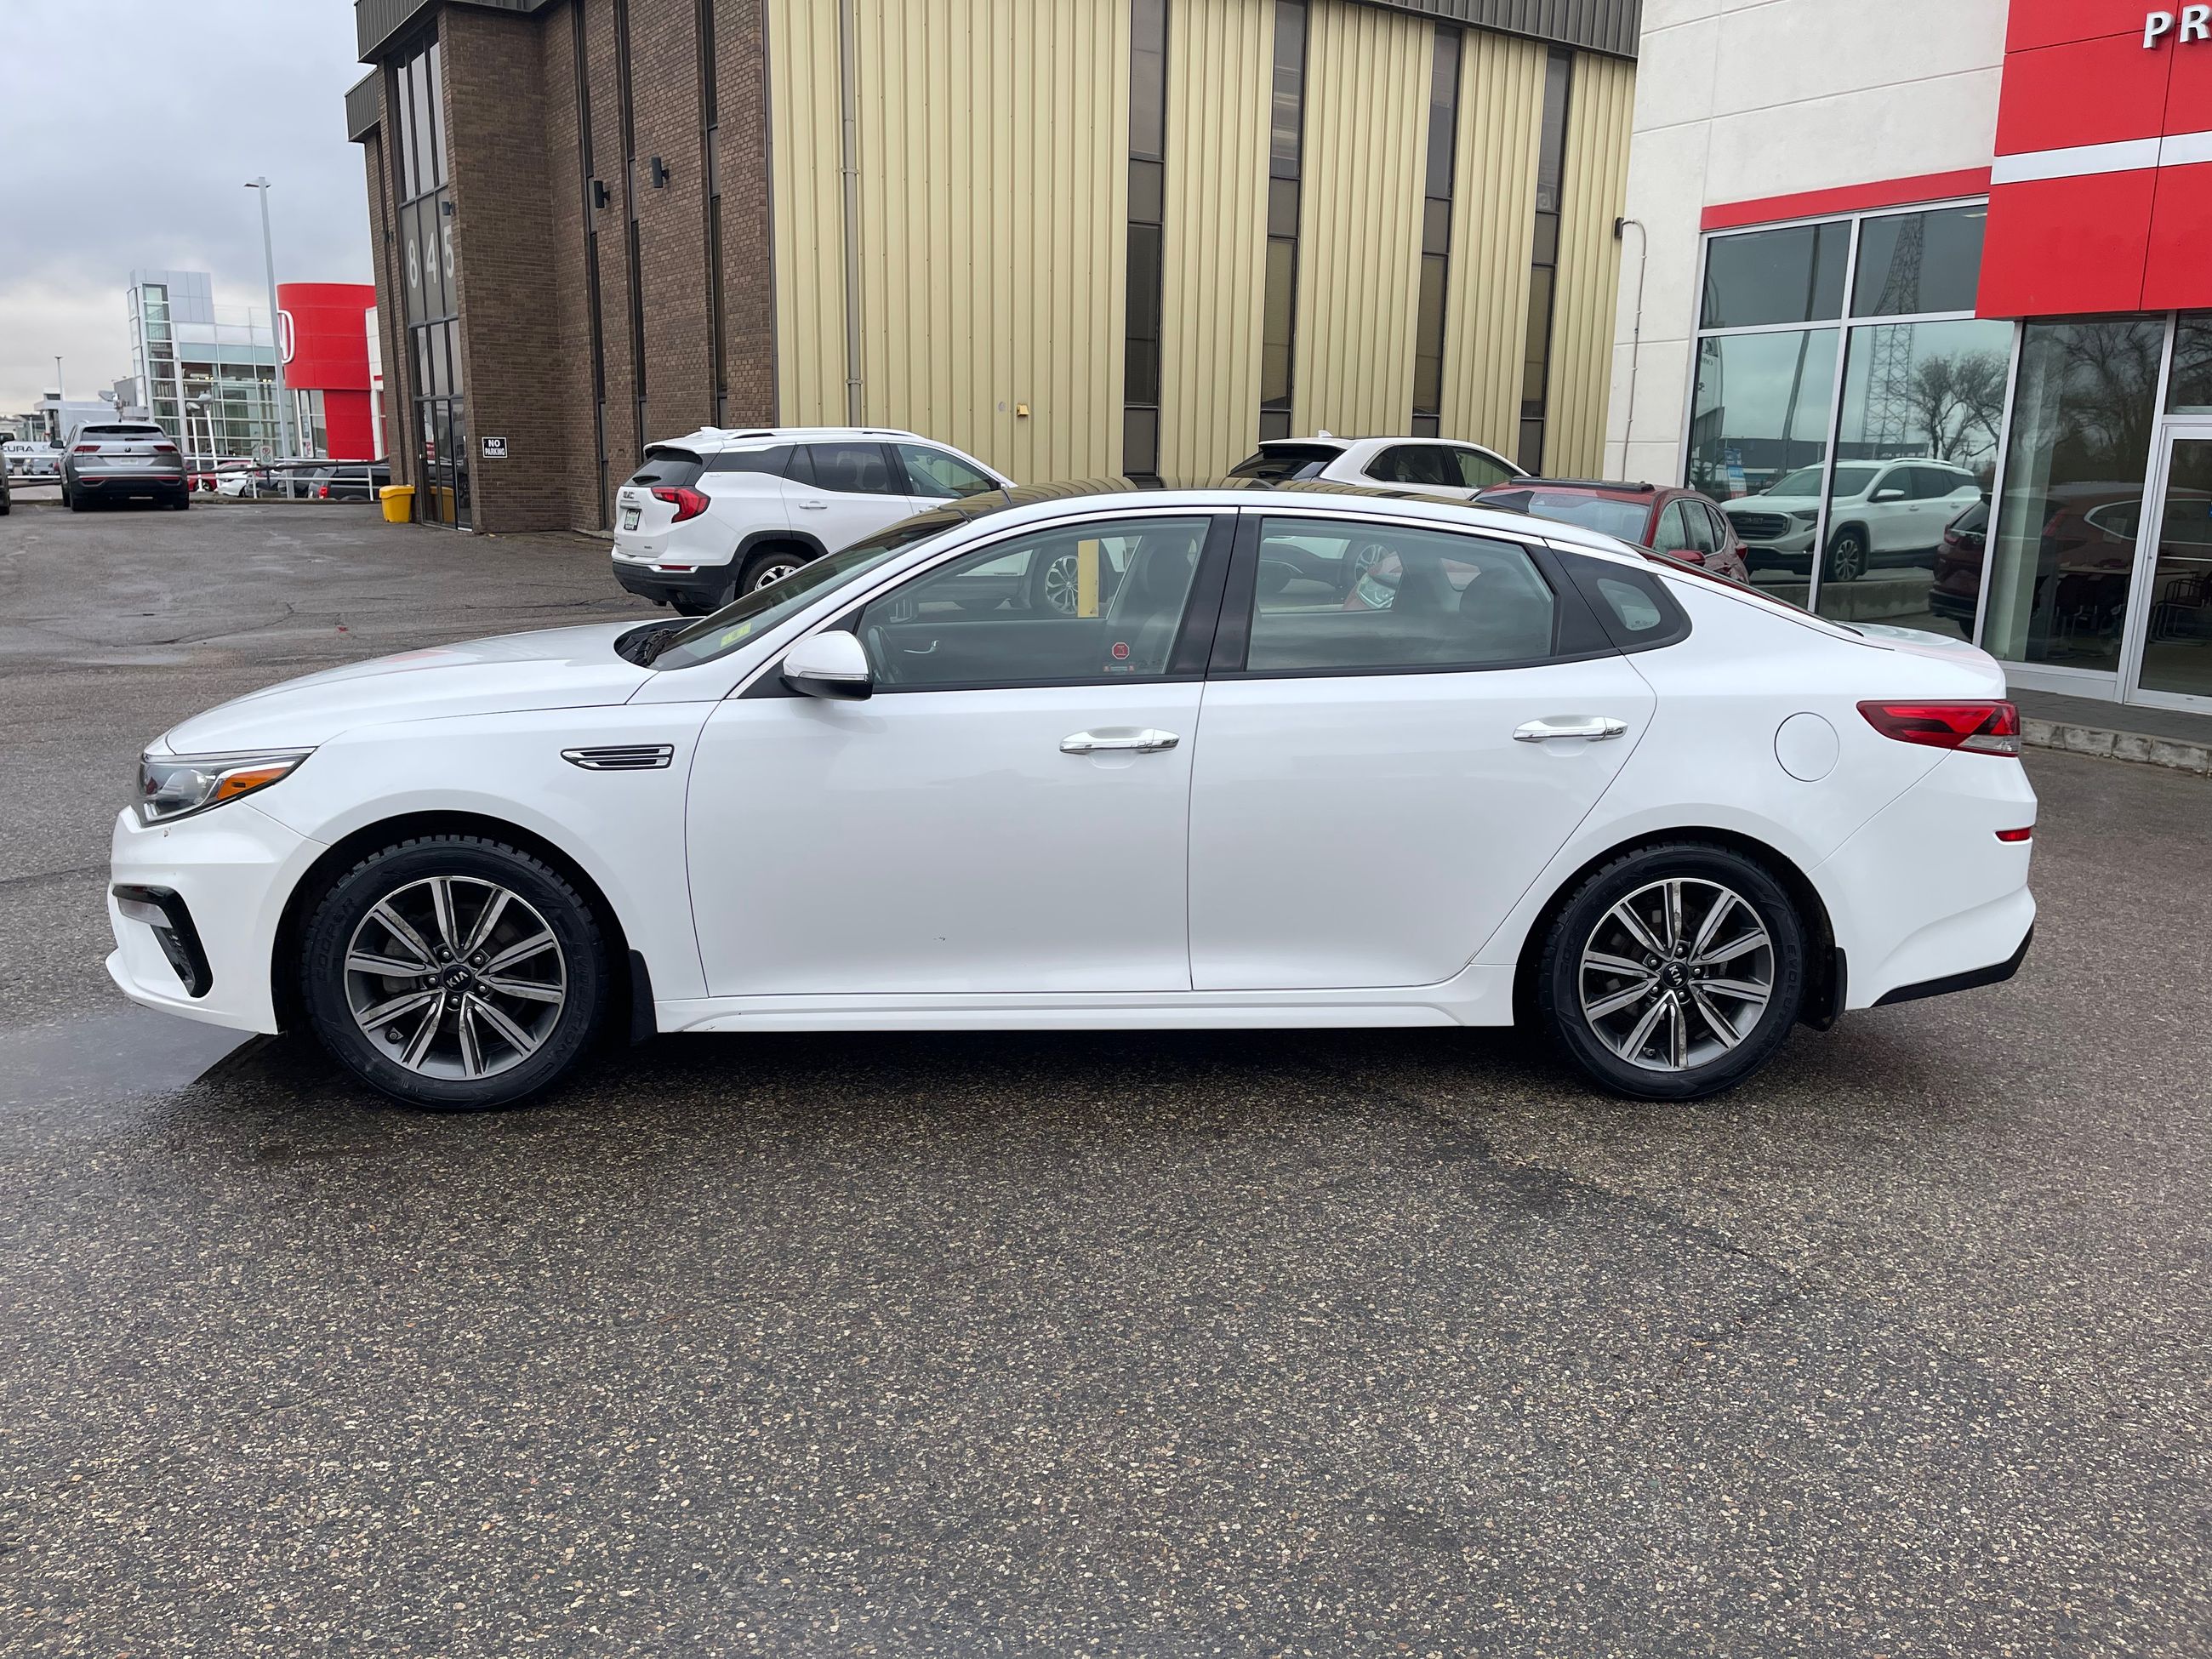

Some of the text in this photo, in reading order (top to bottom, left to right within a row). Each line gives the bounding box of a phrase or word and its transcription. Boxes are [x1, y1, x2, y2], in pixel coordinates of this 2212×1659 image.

[2143, 3, 2212, 48] PR
[408, 225, 454, 288] 845
[484, 448, 505, 456] PARKING
[487, 439, 501, 448] NO
[446, 971, 469, 988] KIA
[1668, 965, 1682, 986] KIA
